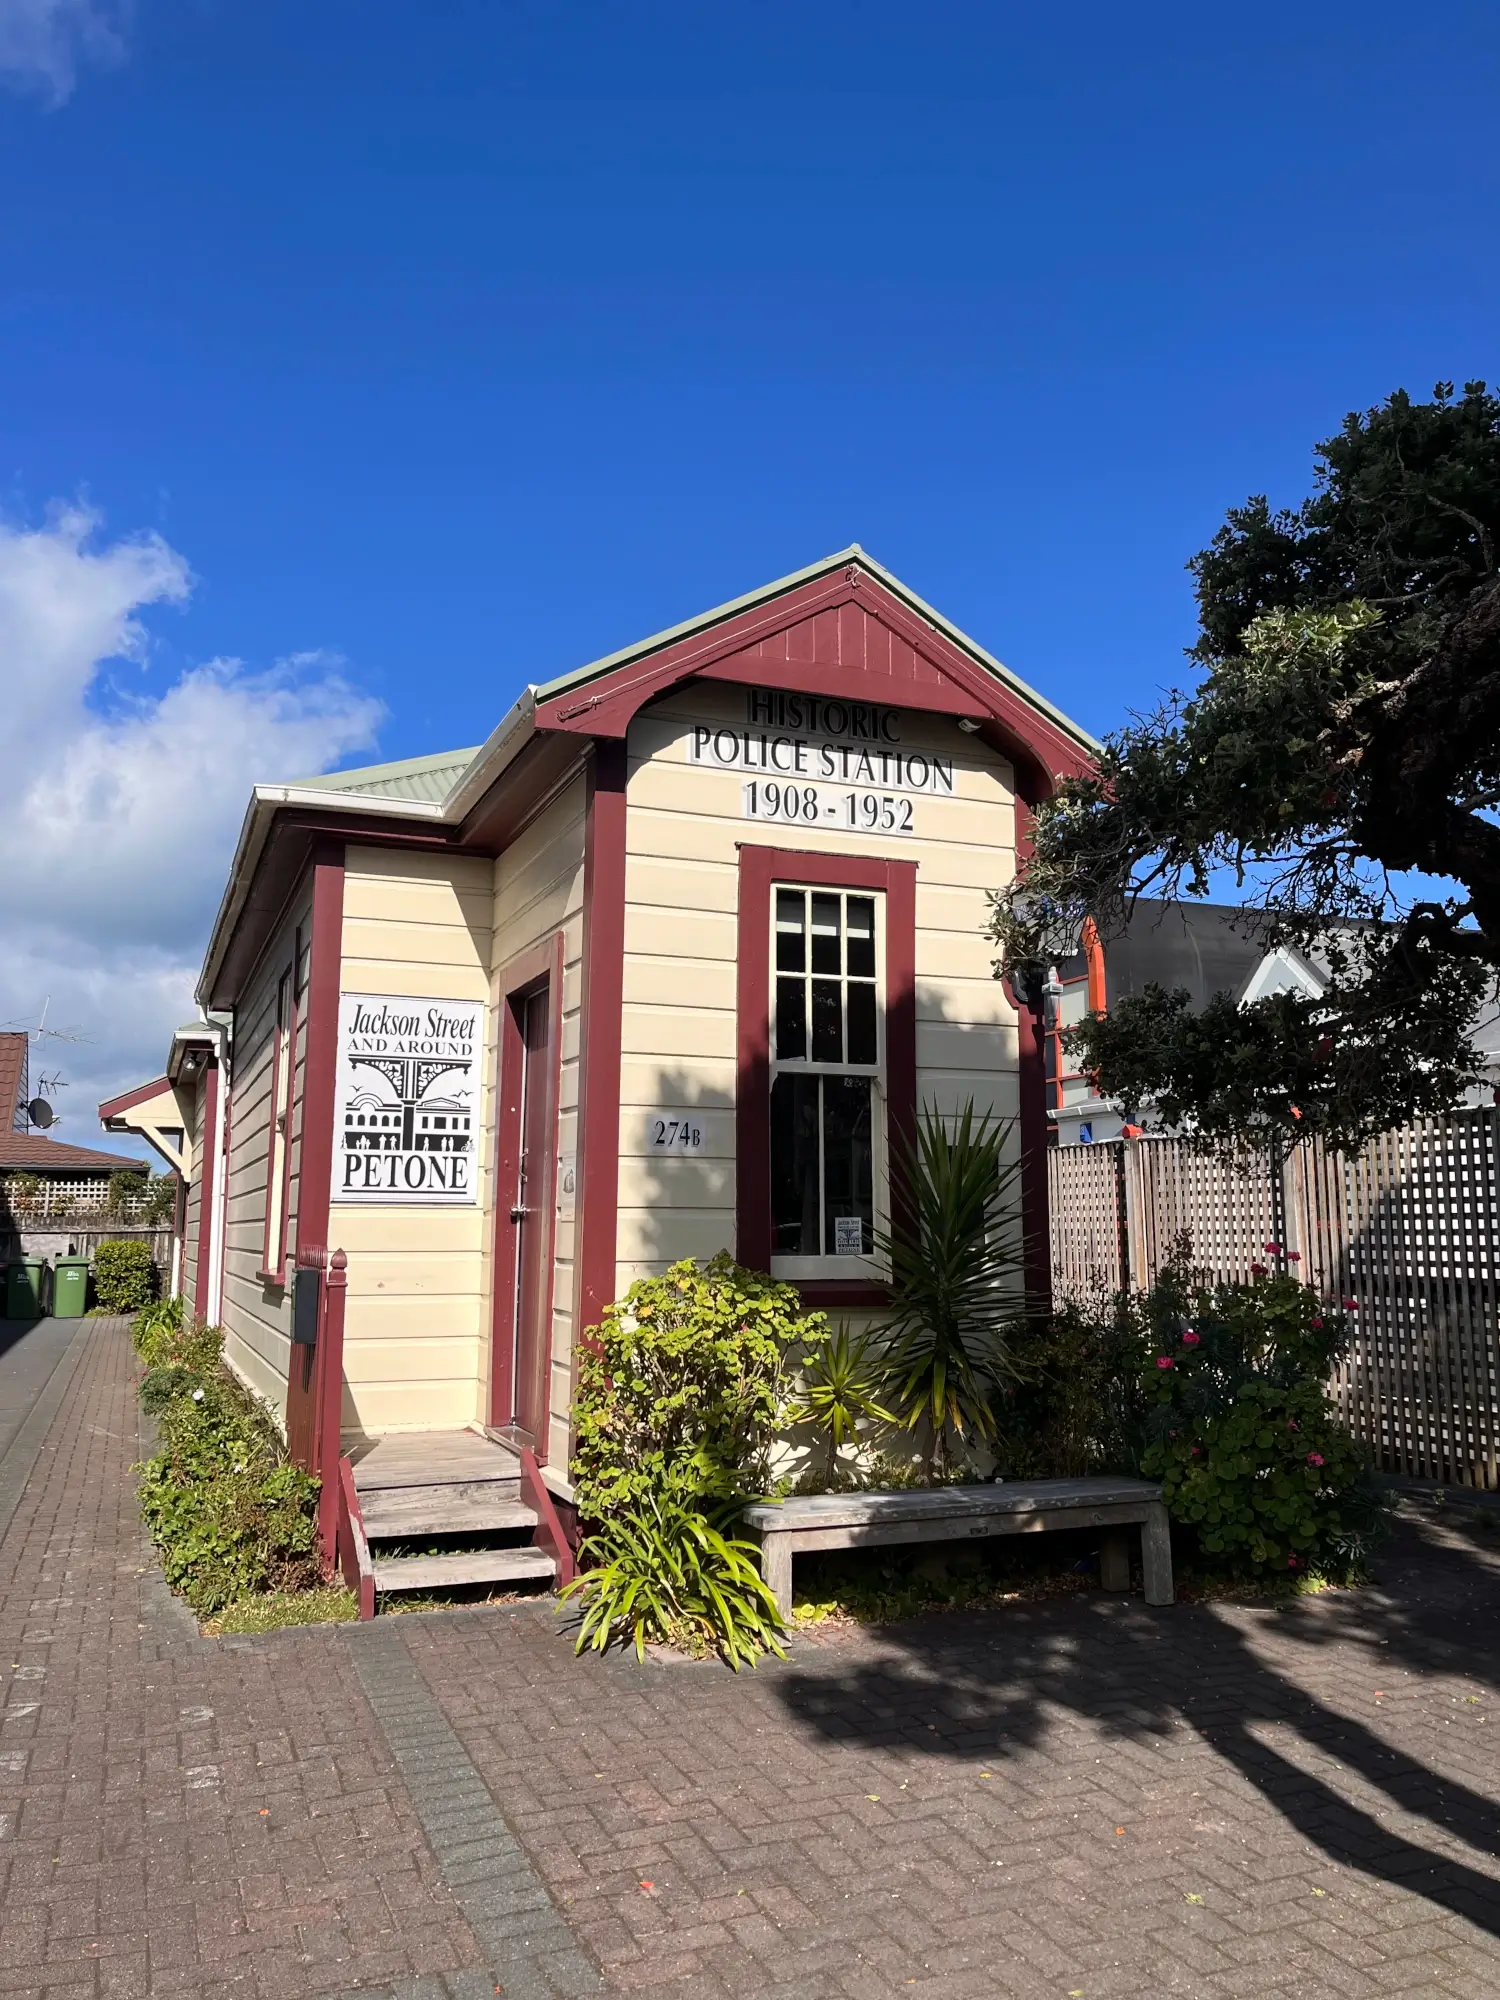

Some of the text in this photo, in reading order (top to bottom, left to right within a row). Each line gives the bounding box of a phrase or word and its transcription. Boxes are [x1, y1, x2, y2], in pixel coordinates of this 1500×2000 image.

[751, 689, 901, 743] HISTORIC
[694, 725, 953, 792] POLICE STATION
[348, 1004, 476, 1040] Jackson Street
[347, 1038, 473, 1056] AND AROUND
[655, 1120, 701, 1146] 274B
[342, 1153, 468, 1189] PETONE
